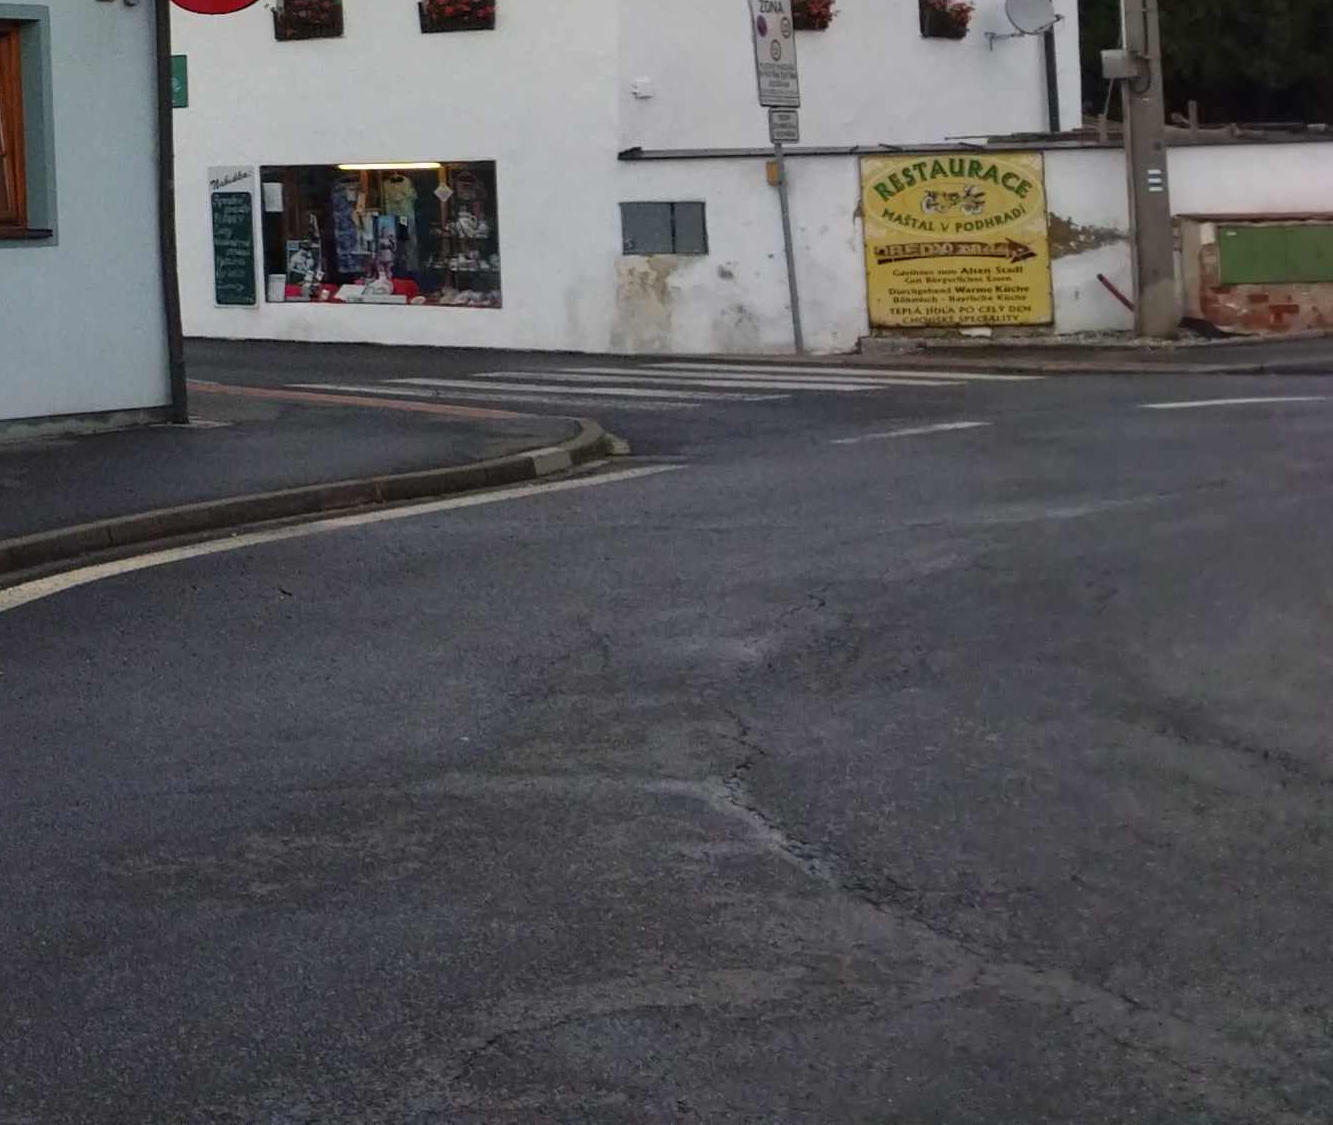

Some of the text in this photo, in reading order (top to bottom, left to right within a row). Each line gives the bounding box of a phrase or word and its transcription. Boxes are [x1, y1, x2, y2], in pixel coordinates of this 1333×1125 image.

[873, 158, 1033, 202] RESTAURACE
[882, 203, 1028, 233] MAŠTAL V PODHRADÍ
[960, 266, 992, 275] Alten
[954, 286, 993, 294] Warme
[994, 284, 1030, 293] Küche
[959, 306, 975, 314] PO
